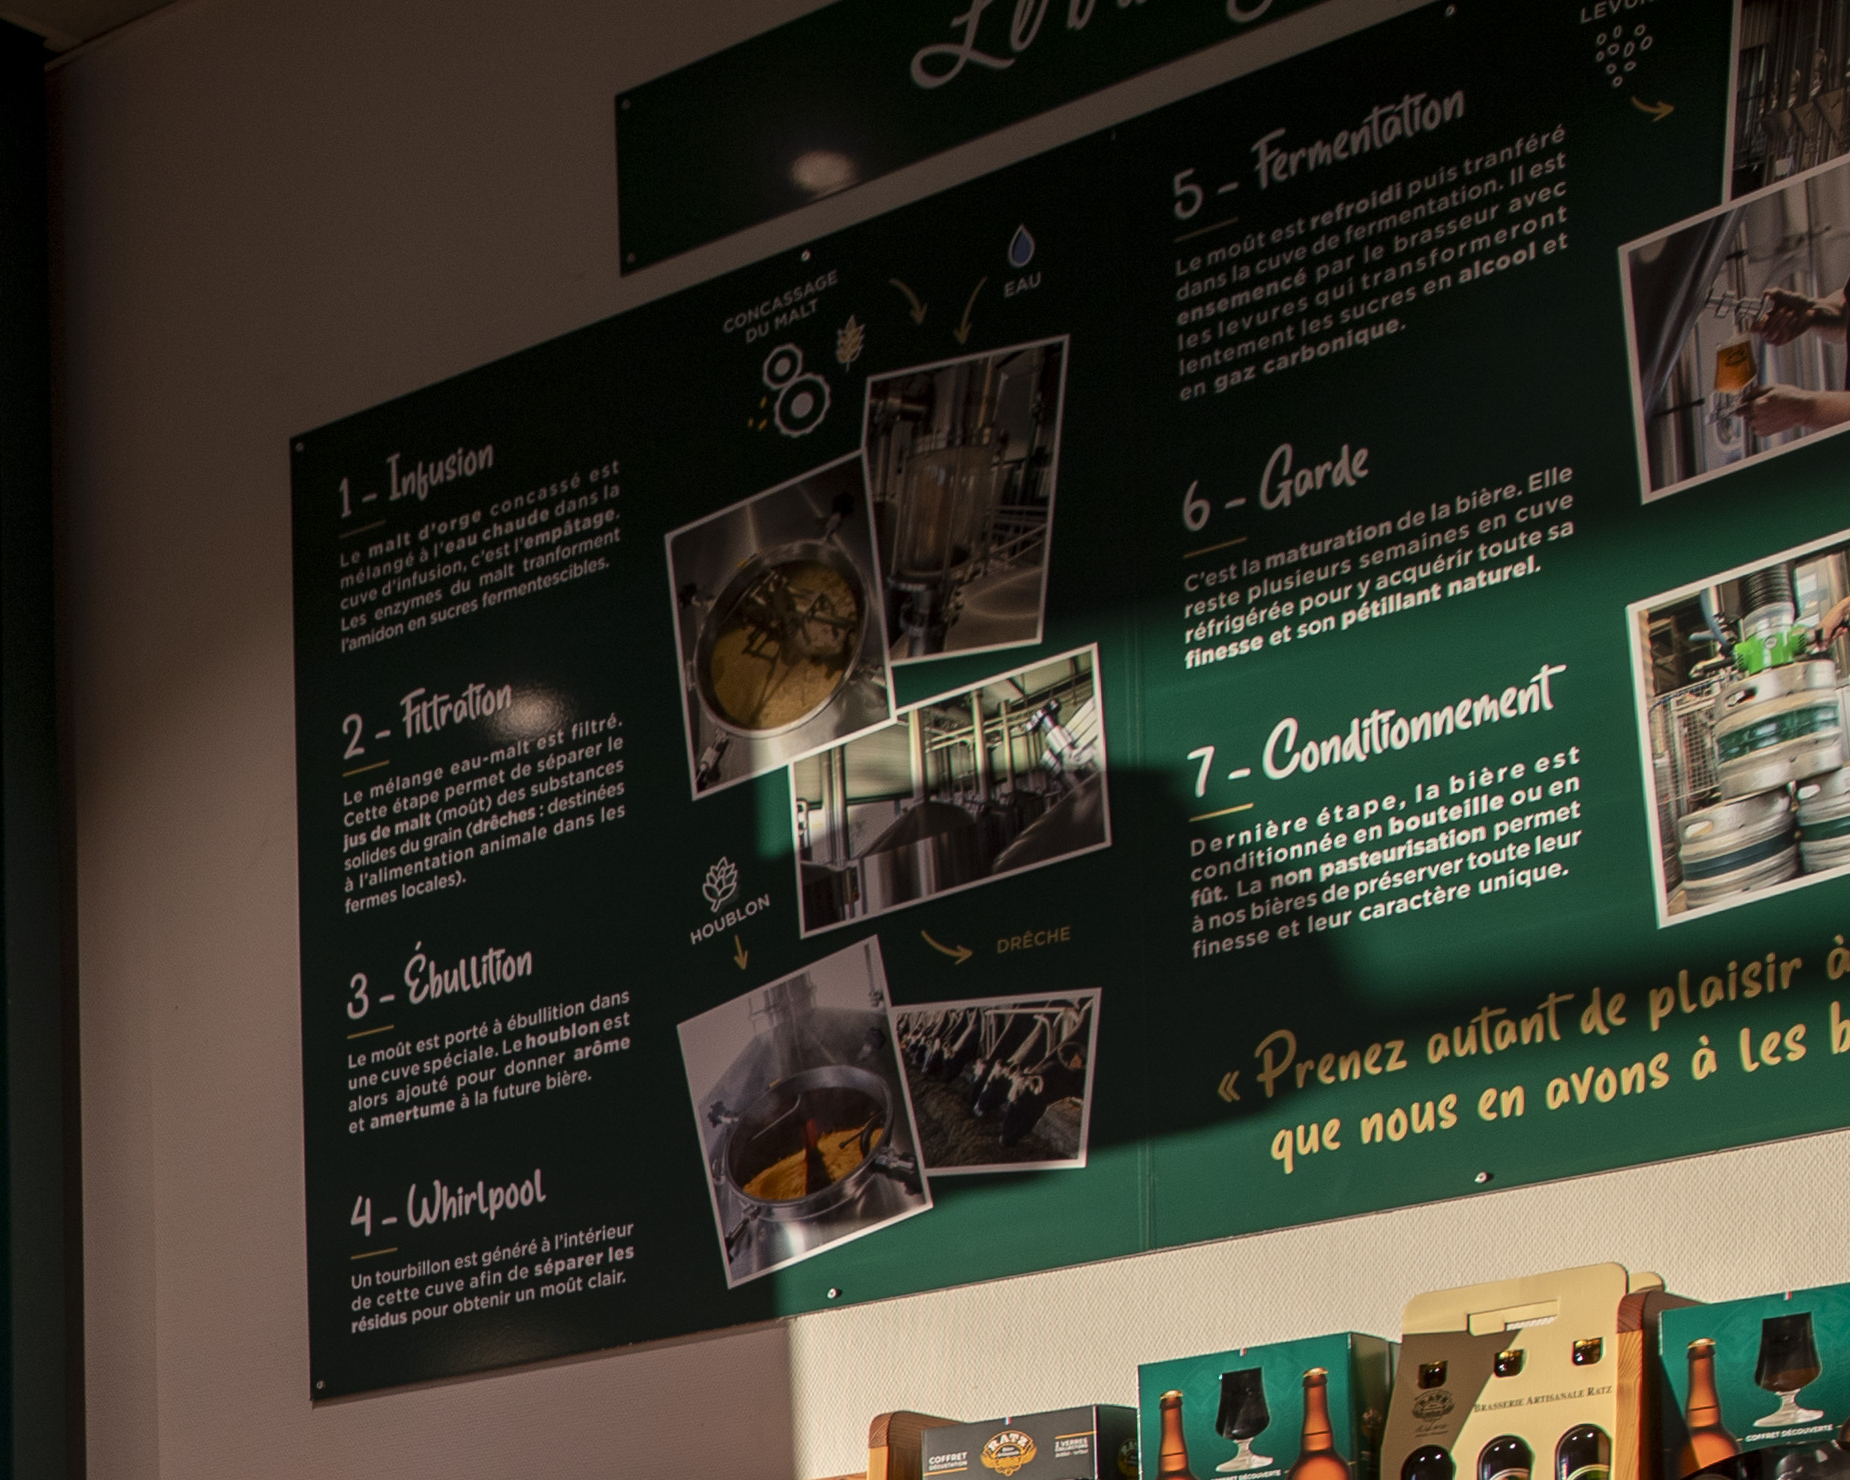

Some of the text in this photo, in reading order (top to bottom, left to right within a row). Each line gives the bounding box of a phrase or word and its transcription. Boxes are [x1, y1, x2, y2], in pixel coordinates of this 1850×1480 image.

[1174, 168, 1203, 220] 5
[1251, 90, 1464, 190] Fermentation
[723, 269, 838, 333] CONCASSAGE
[746, 298, 818, 343] DU MALT
[1004, 272, 1041, 298] EAU
[339, 477, 352, 518] 1
[386, 444, 493, 501] Infusion
[1183, 480, 1210, 531] 6
[1260, 443, 1368, 510] Garde
[342, 714, 364, 760] 2
[400, 683, 512, 738] Filtration
[1187, 746, 1214, 798] 7
[1263, 664, 1566, 780] Conditionnement
[1190, 746, 1579, 856] Dernière étape, la bière est
[1191, 777, 1580, 881] conditionnée en bouteille ou en
[1191, 801, 1580, 907] fût. La non pasteurisation permet
[1192, 830, 1582, 932] à nos bières de préserver toute leur
[690, 894, 770, 944] HOUBLON
[997, 926, 1070, 954] DRÊCHE
[1192, 863, 1568, 958] finesse et leur caractère unique.
[347, 973, 368, 1019] 3
[404, 942, 532, 1004] Ébullition
[1255, 1029, 1407, 1098] Prenez
[1428, 992, 1574, 1064] autant
[1580, 987, 1626, 1035] de
[1650, 952, 1802, 1032] plaisir
[1827, 935, 1850, 980] à
[1271, 1118, 1340, 1174] que
[1361, 1094, 1457, 1144] nous
[1478, 1086, 1524, 1120] en
[1546, 1052, 1669, 1110] avons
[1692, 1035, 1717, 1080] à
[1740, 1024, 1806, 1072] les
[350, 1196, 371, 1236] 4
[408, 1168, 546, 1228] Whirlpool
[351, 1274, 372, 1289] Un
[376, 1260, 450, 1284] tourbillon
[454, 1252, 477, 1268] est
[482, 1239, 537, 1266] généré
[542, 1237, 550, 1252] à
[352, 1246, 634, 1311] de cette cuve afin de séparer les
[352, 1270, 626, 1334] résidus pour obtenir un moût clair.
[929, 1452, 967, 1464] COFFRET
[989, 1434, 1029, 1451] RATZ
[1746, 1425, 1833, 1441] COFFRET DÉCOUVERTE
